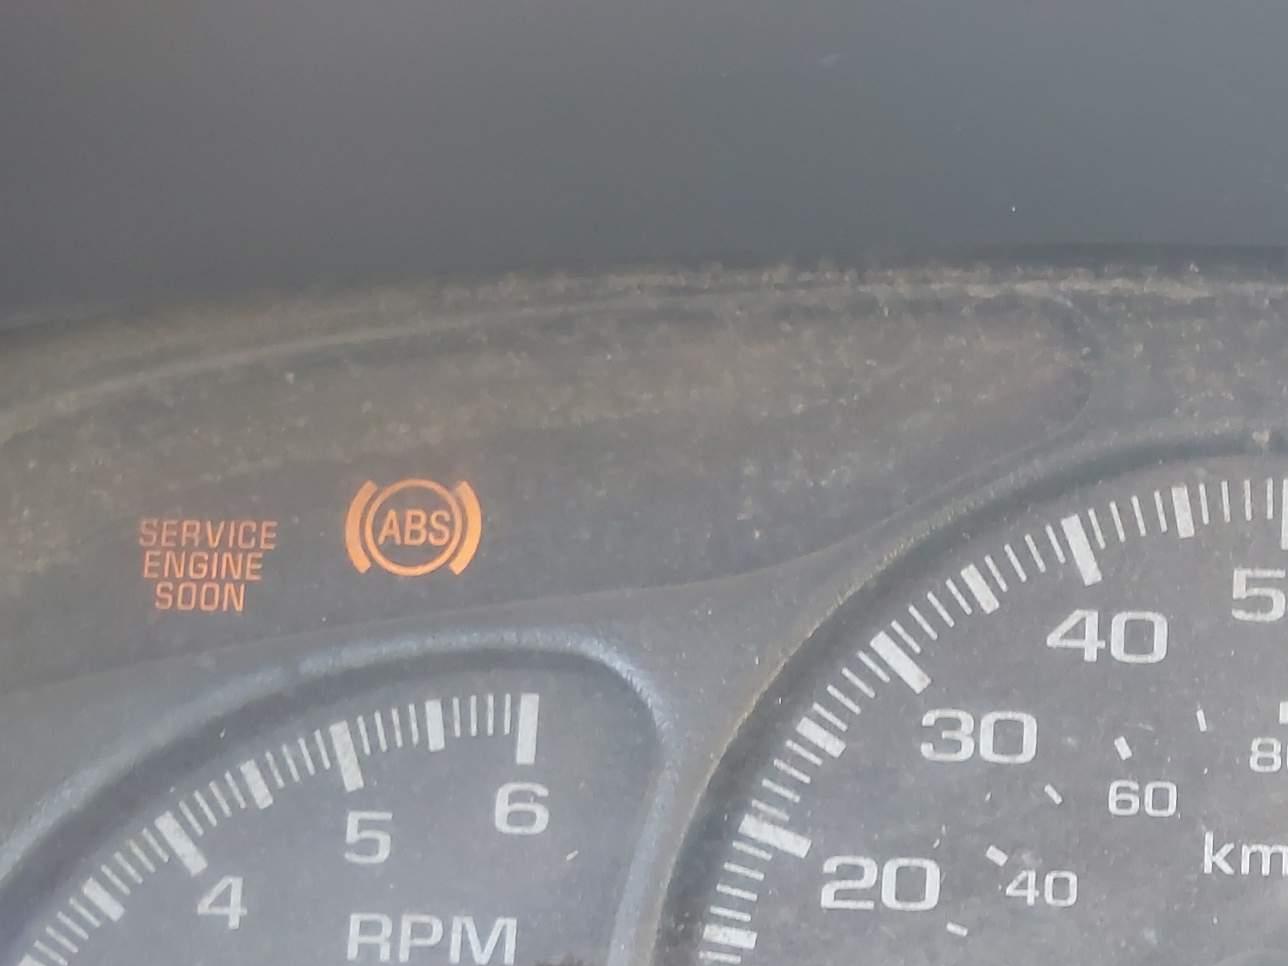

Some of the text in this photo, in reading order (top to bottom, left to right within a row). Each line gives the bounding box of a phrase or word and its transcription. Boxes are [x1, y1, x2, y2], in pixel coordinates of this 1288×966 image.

[139, 519, 277, 550] SERVICE
[378, 510, 452, 548] ABS
[143, 552, 263, 581] ENGINE
[154, 583, 245, 612] SOON
[1046, 608, 1168, 664] 40
[920, 709, 1038, 764] 30
[495, 782, 550, 835] 6
[1108, 780, 1177, 817] 60
[344, 811, 393, 864] 5
[197, 876, 248, 930] 4
[820, 856, 941, 911] 20
[1004, 870, 1078, 908] 40
[346, 912, 518, 966] RPM
